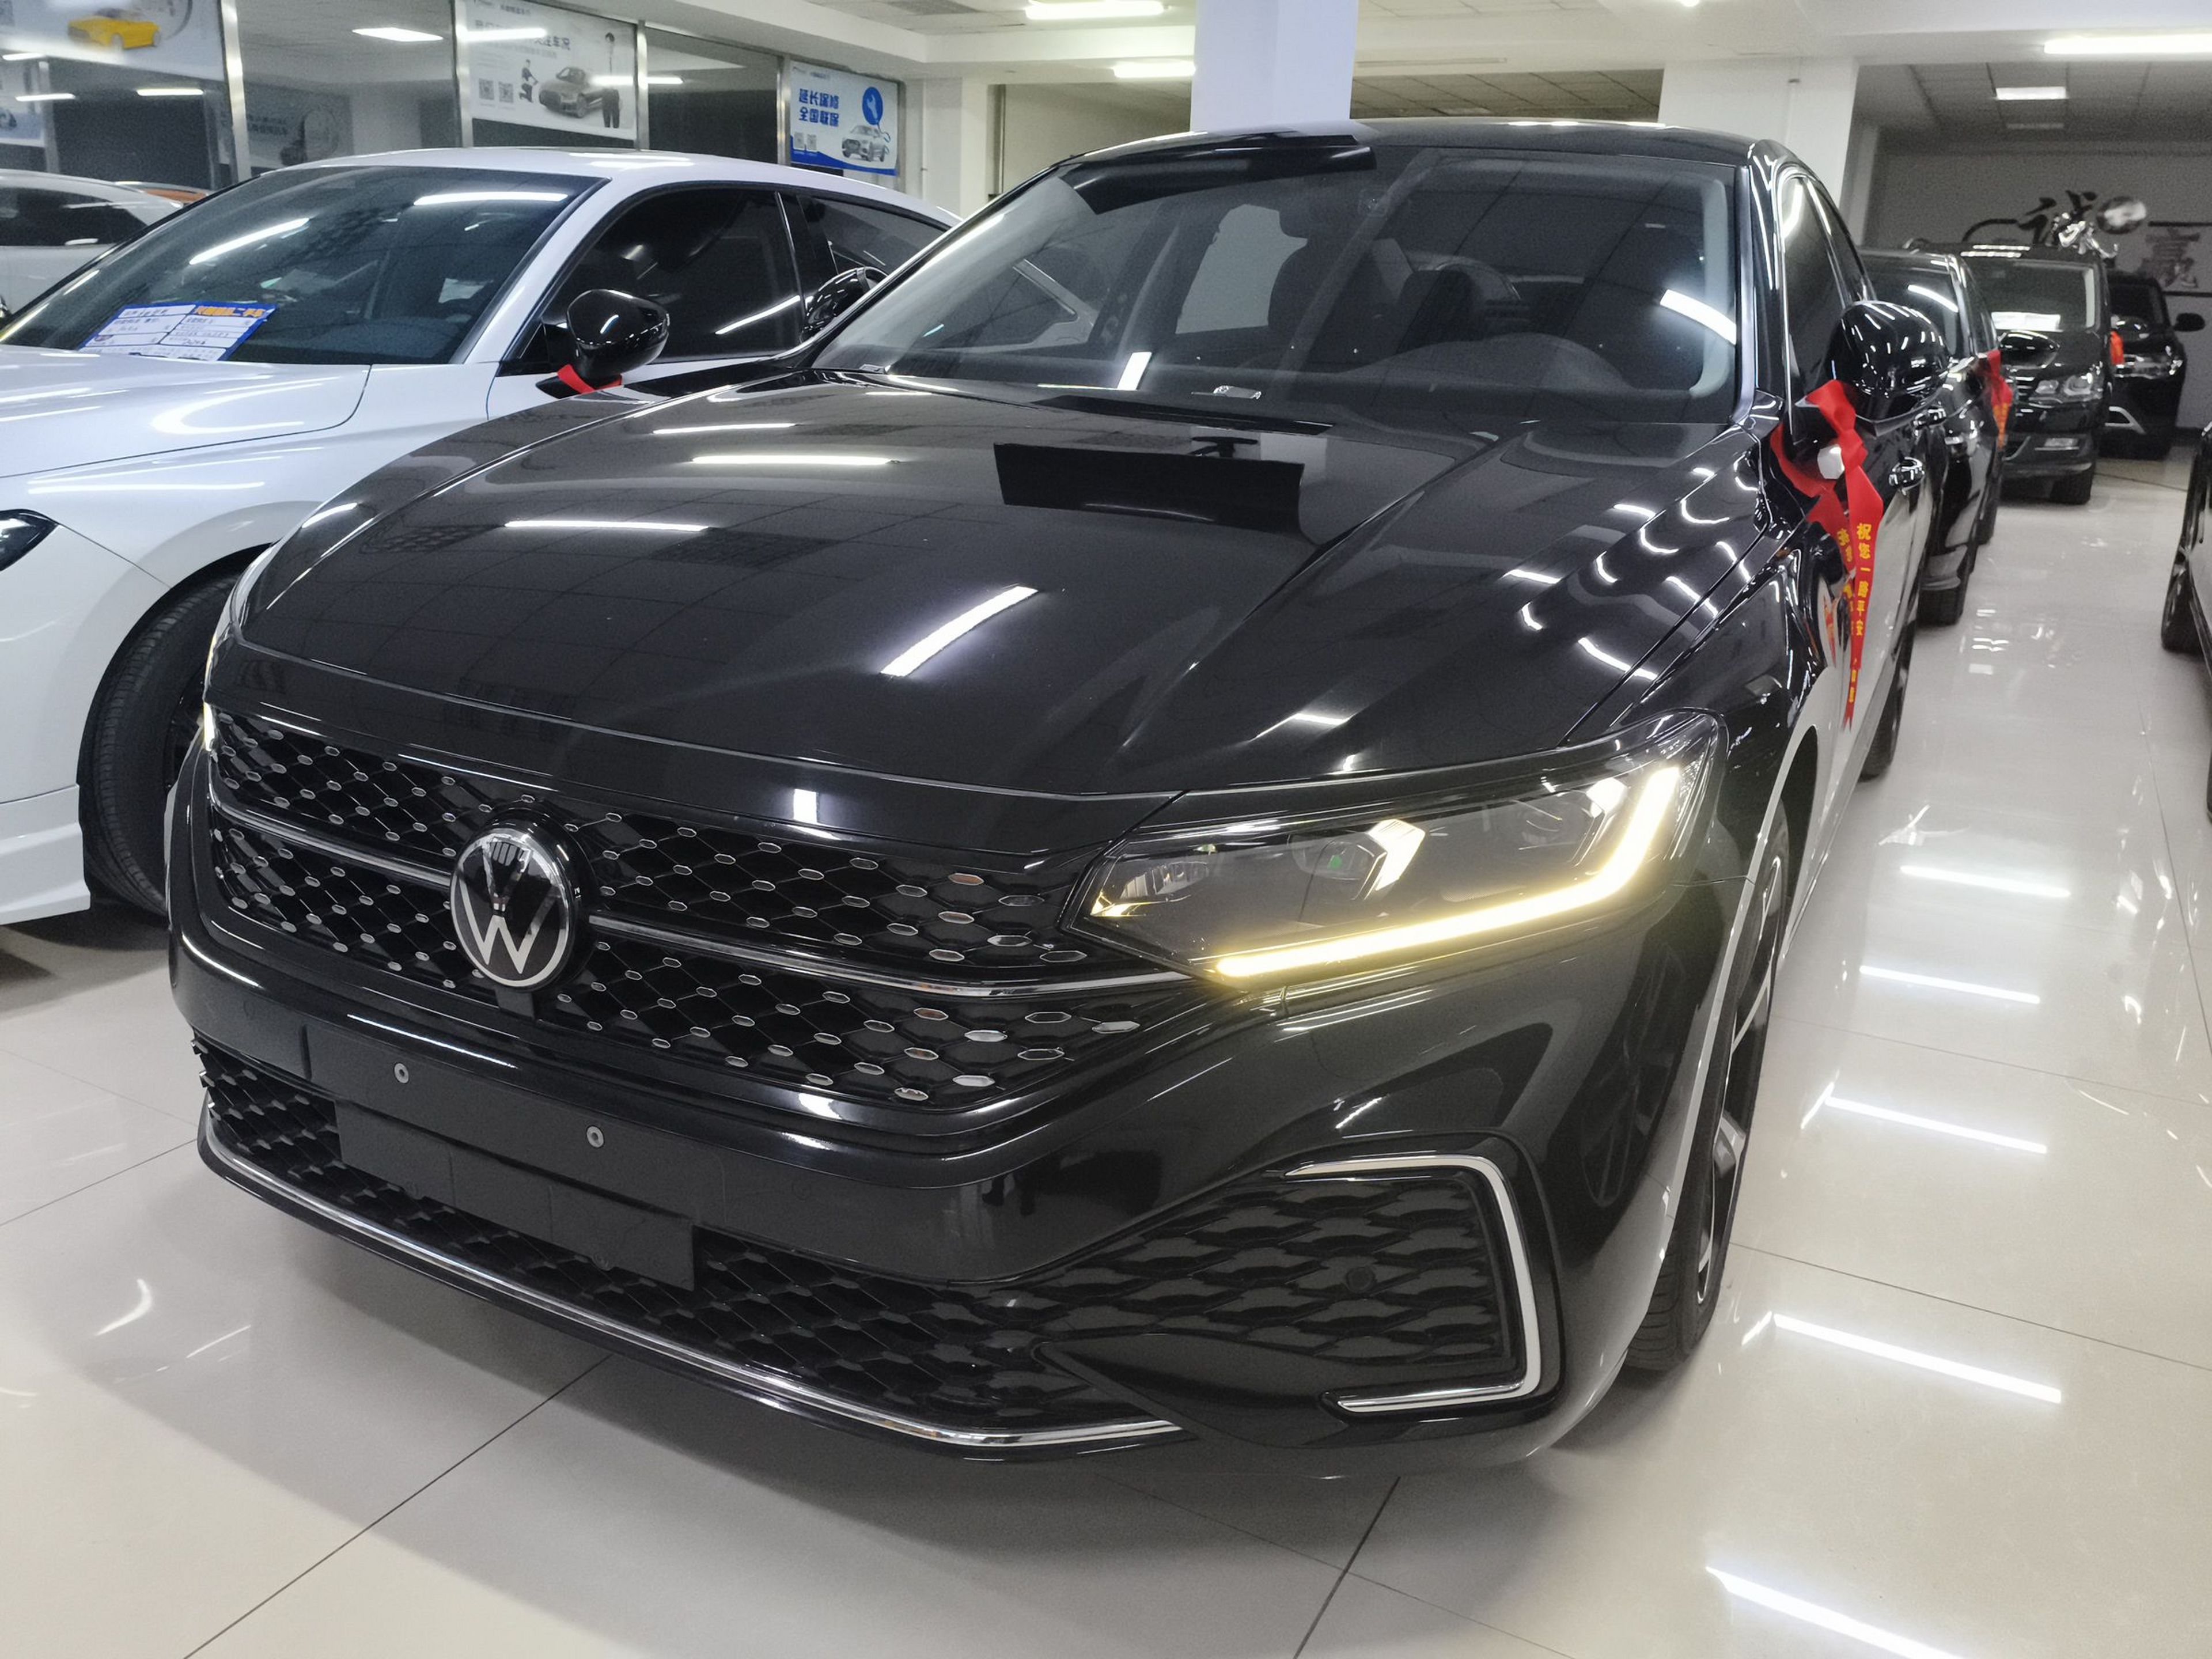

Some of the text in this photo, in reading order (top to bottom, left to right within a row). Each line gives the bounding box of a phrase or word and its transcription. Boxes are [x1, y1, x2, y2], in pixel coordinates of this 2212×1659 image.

[798, 88, 839, 109] 延长保修
[798, 106, 839, 127] 全国联保
[1856, 522, 1872, 636] 祝您一路平安
